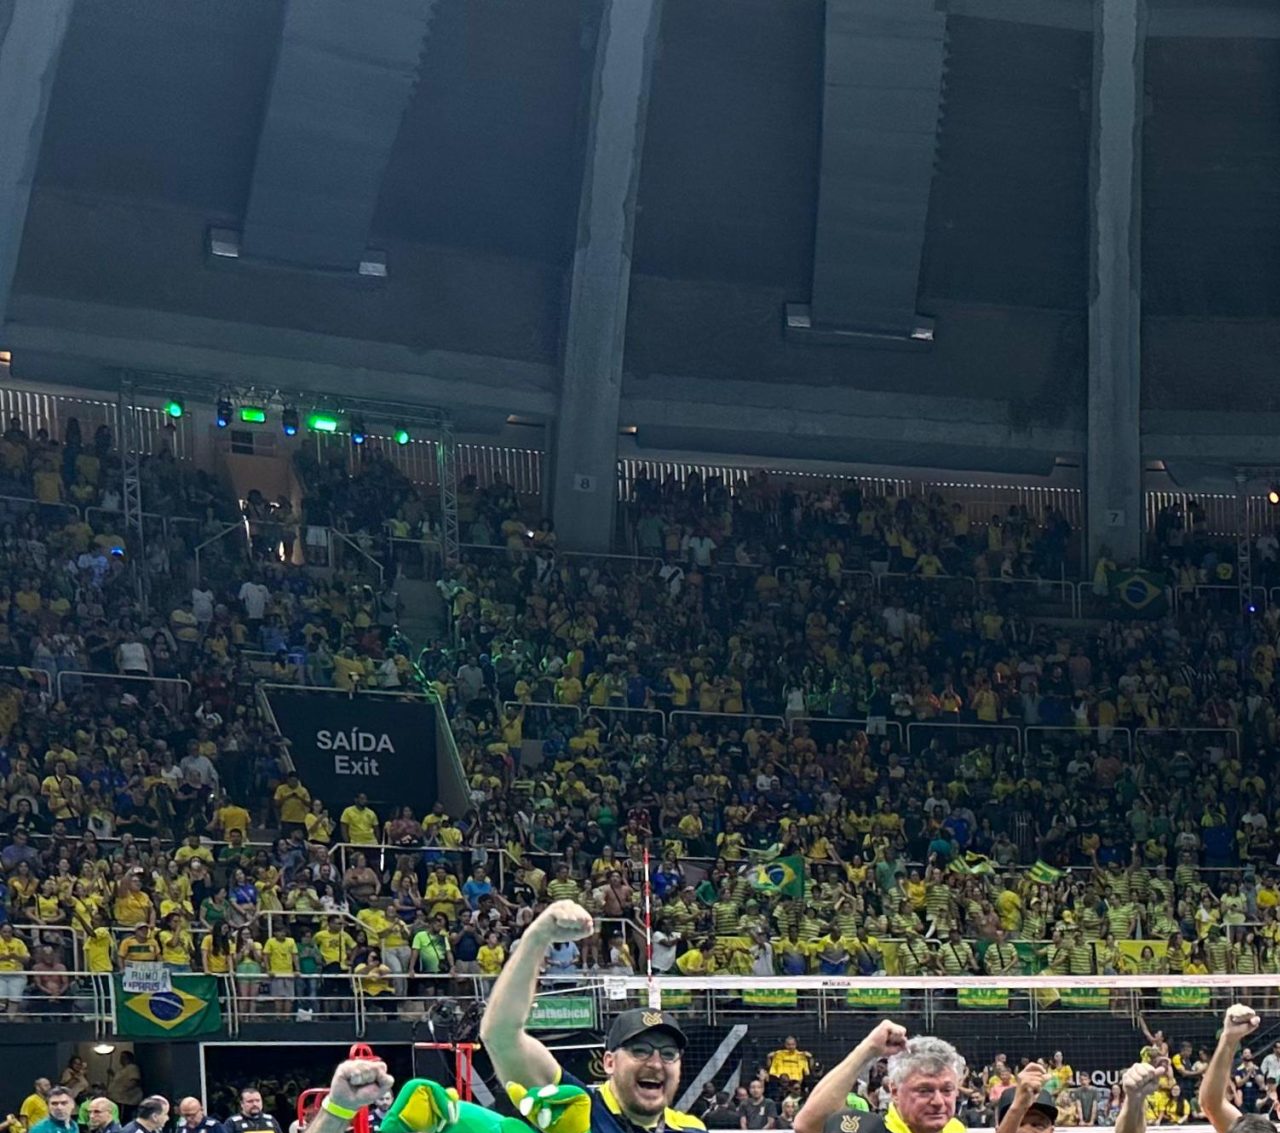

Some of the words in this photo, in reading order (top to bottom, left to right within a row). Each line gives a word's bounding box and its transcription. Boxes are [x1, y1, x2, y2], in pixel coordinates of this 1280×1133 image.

[580, 478, 590, 489] 8
[1110, 513, 1119, 523] 7
[316, 727, 395, 753] SAÍDA
[334, 755, 379, 776] Exit
